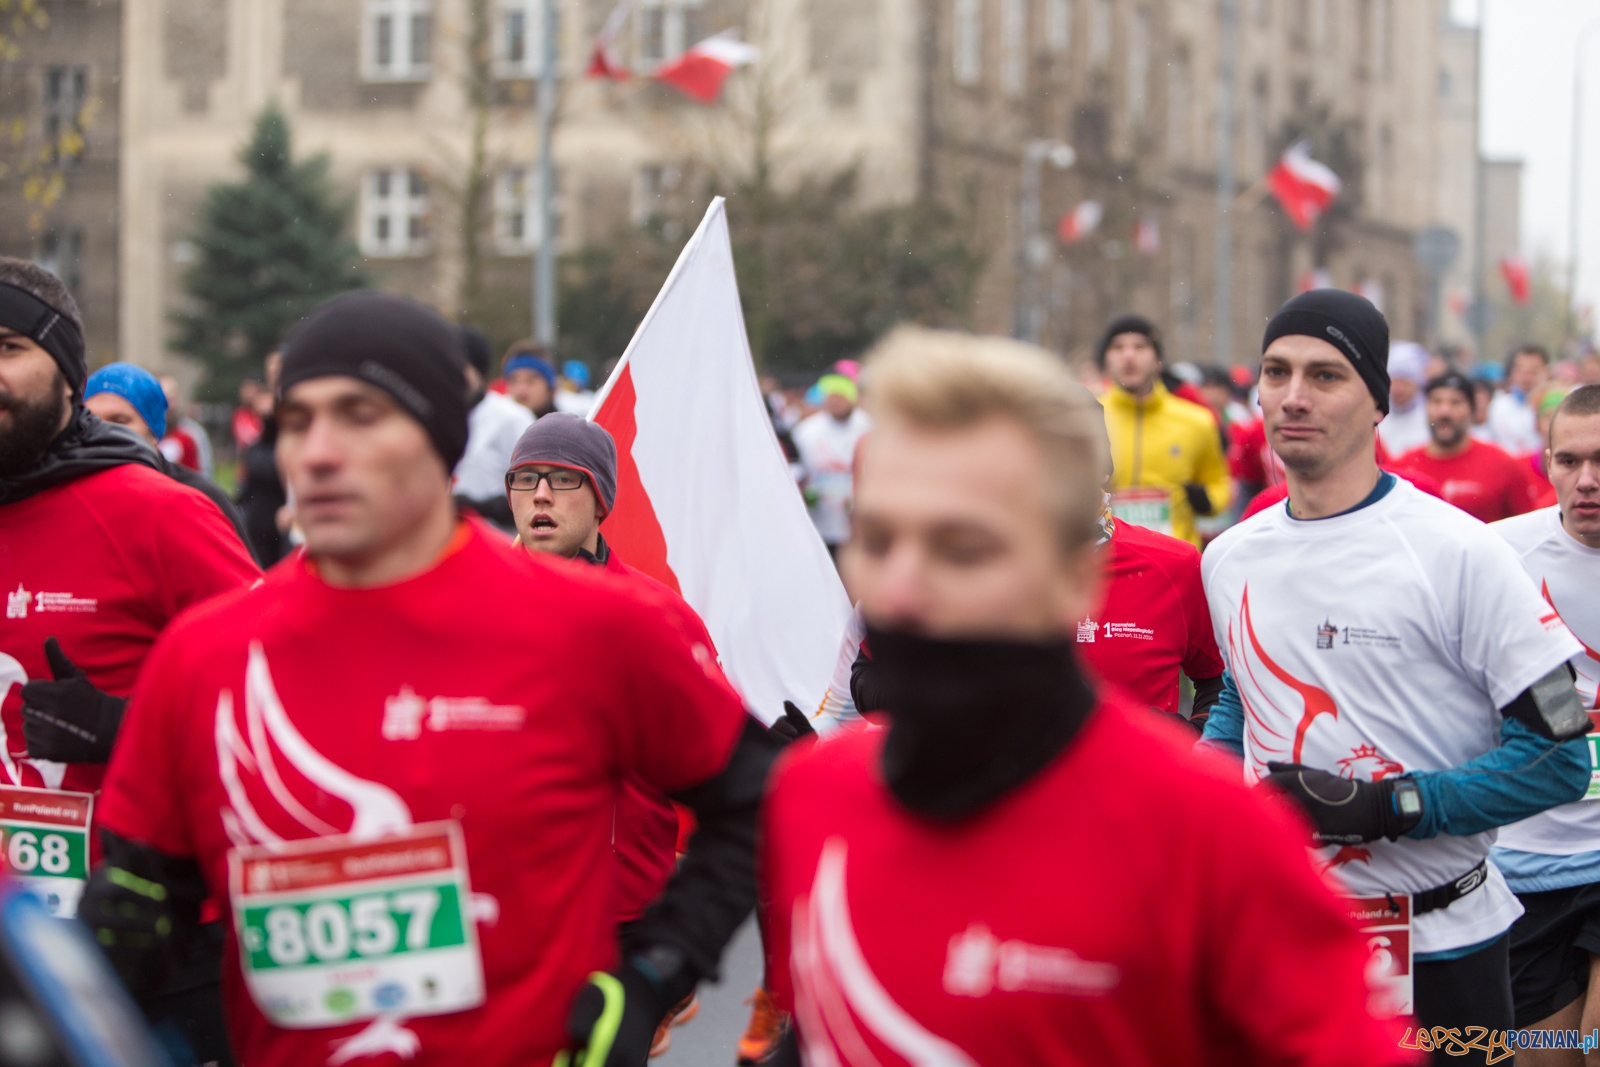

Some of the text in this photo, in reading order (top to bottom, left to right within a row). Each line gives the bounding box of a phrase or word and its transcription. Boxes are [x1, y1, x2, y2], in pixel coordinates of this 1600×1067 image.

[1103, 622, 1113, 638] 1
[13, 802, 79, 820] RunPoland.org
[265, 890, 442, 966] 8057
